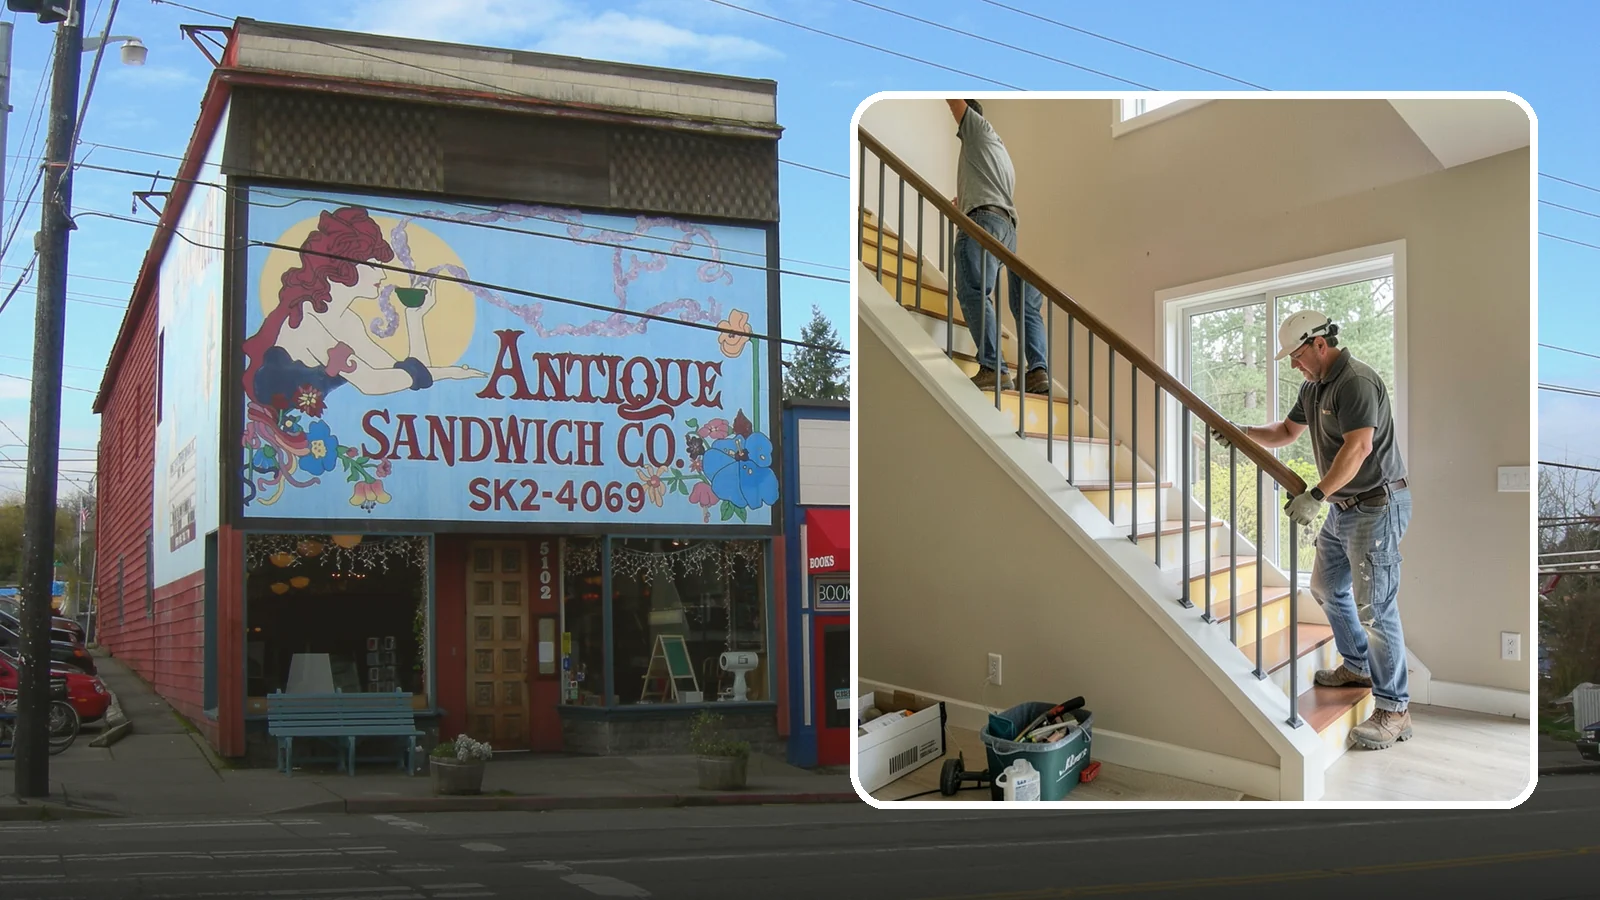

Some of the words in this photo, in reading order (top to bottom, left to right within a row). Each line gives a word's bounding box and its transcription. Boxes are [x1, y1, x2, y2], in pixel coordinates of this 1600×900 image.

[477, 329, 723, 421] ANTIQUE
[361, 408, 605, 468] SANDWICH
[616, 421, 685, 469] CO.
[469, 476, 645, 513] SK2-4069
[810, 555, 835, 569] BOOKS
